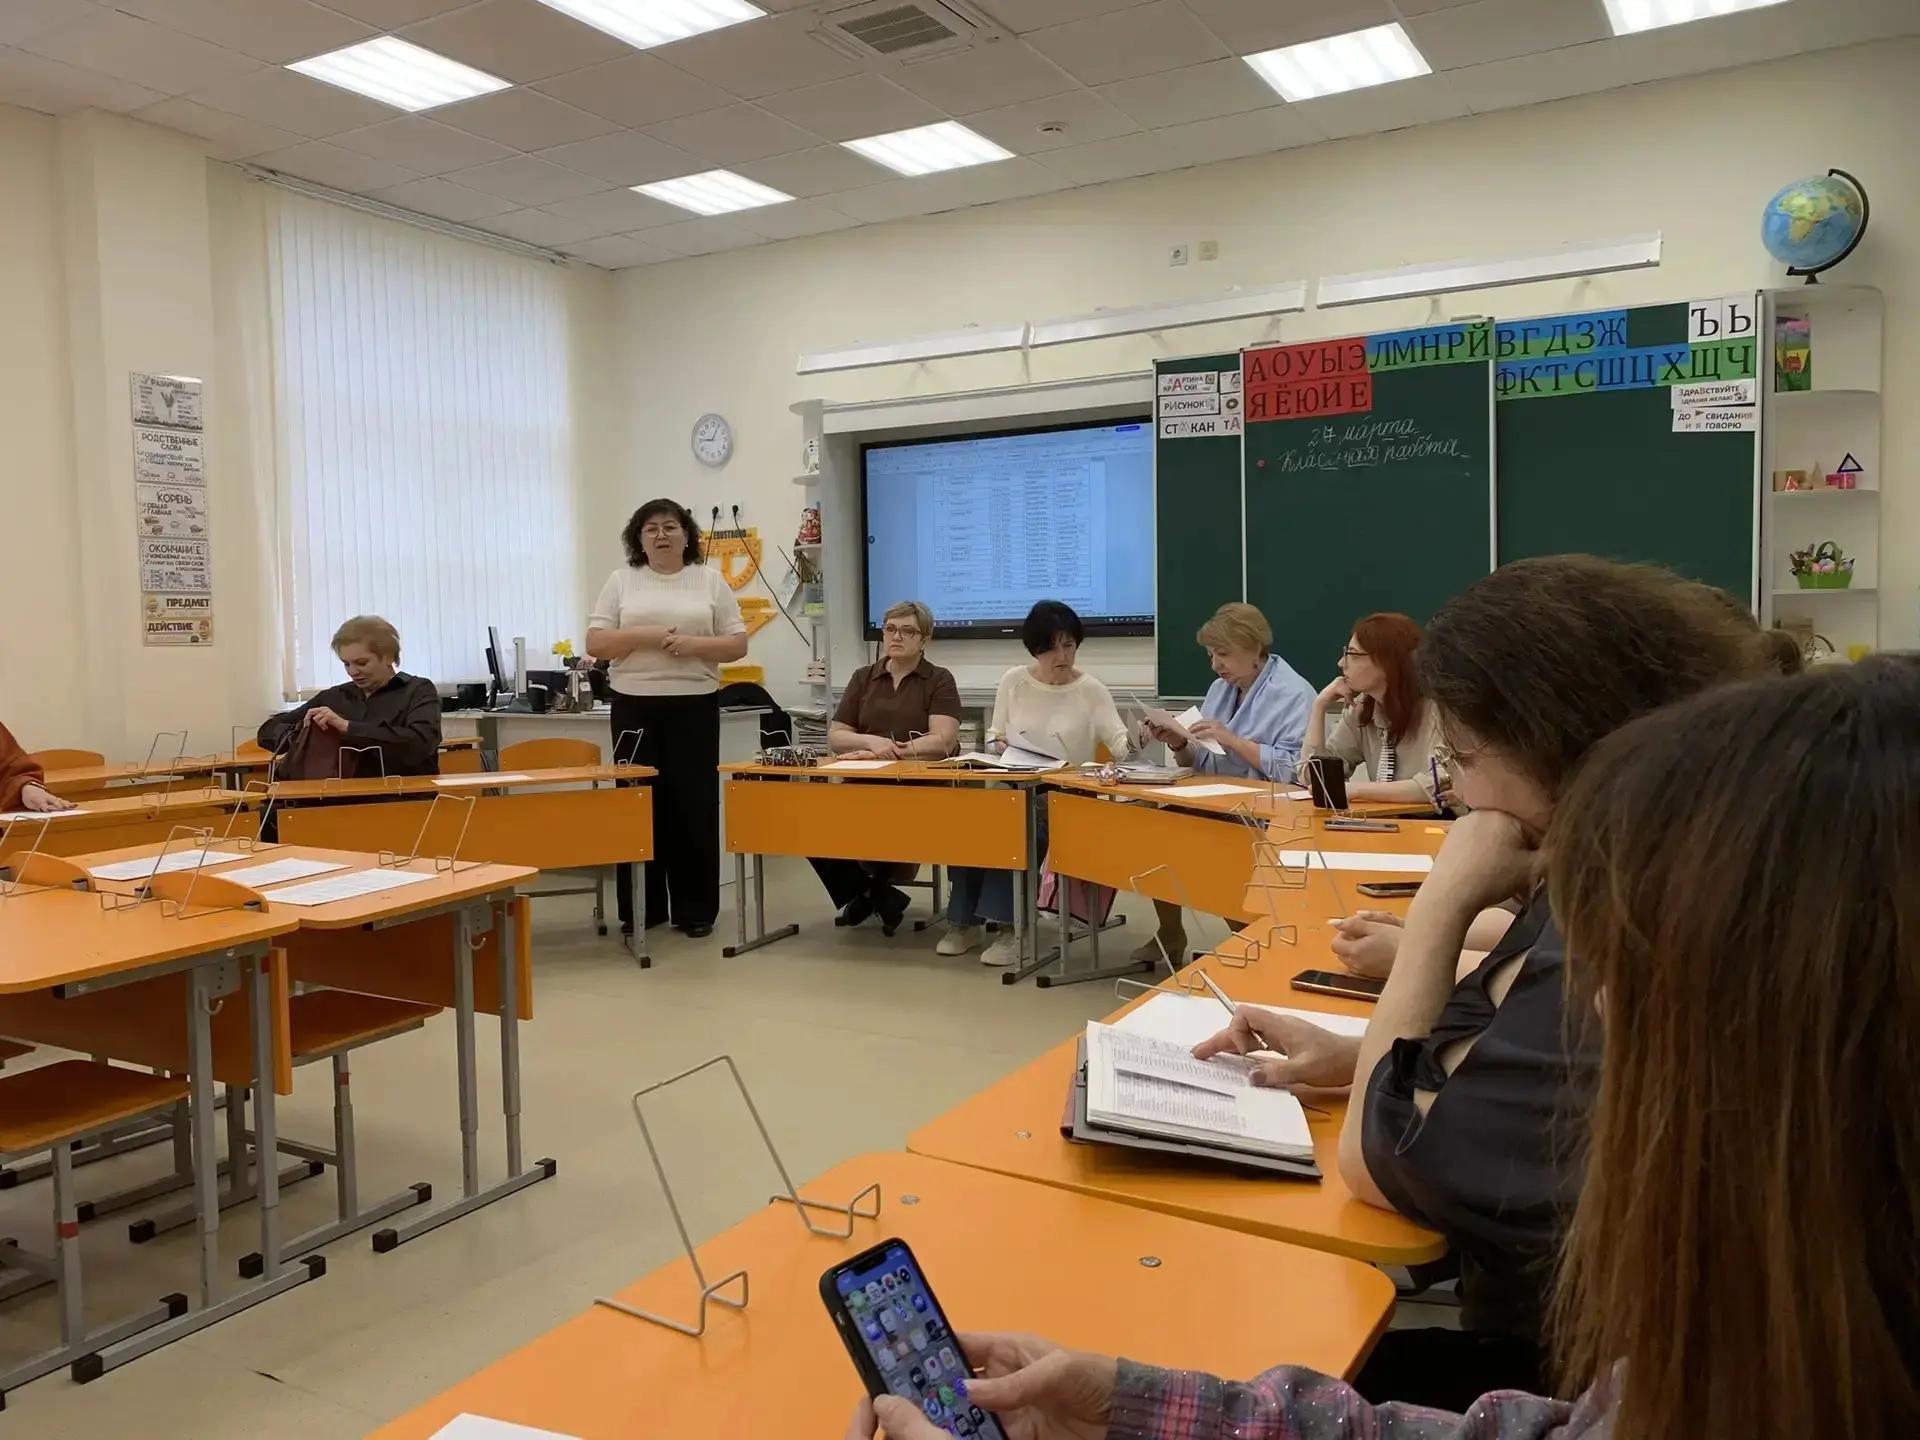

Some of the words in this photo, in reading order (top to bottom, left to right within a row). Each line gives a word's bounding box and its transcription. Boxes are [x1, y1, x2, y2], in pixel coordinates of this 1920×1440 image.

[1678, 384, 1739, 397] ЗДРАВСТВУЙТЕ
[1708, 395, 1733, 403] ЖЕЛАЮ
[1164, 400, 1204, 411] РИСУНОК
[1677, 412, 1691, 421] ДО
[1705, 411, 1752, 420] СВИДАНИЯ
[1705, 421, 1742, 429] ГОВОРЮ
[141, 433, 199, 447] РОДСТВЕННЫЕ
[160, 443, 183, 452] СЛОВА
[157, 493, 192, 505] КОРЕНЬ
[166, 598, 210, 608] ПРЕДМЕТ
[147, 620, 194, 632] ДЕЙСТВИЕ
